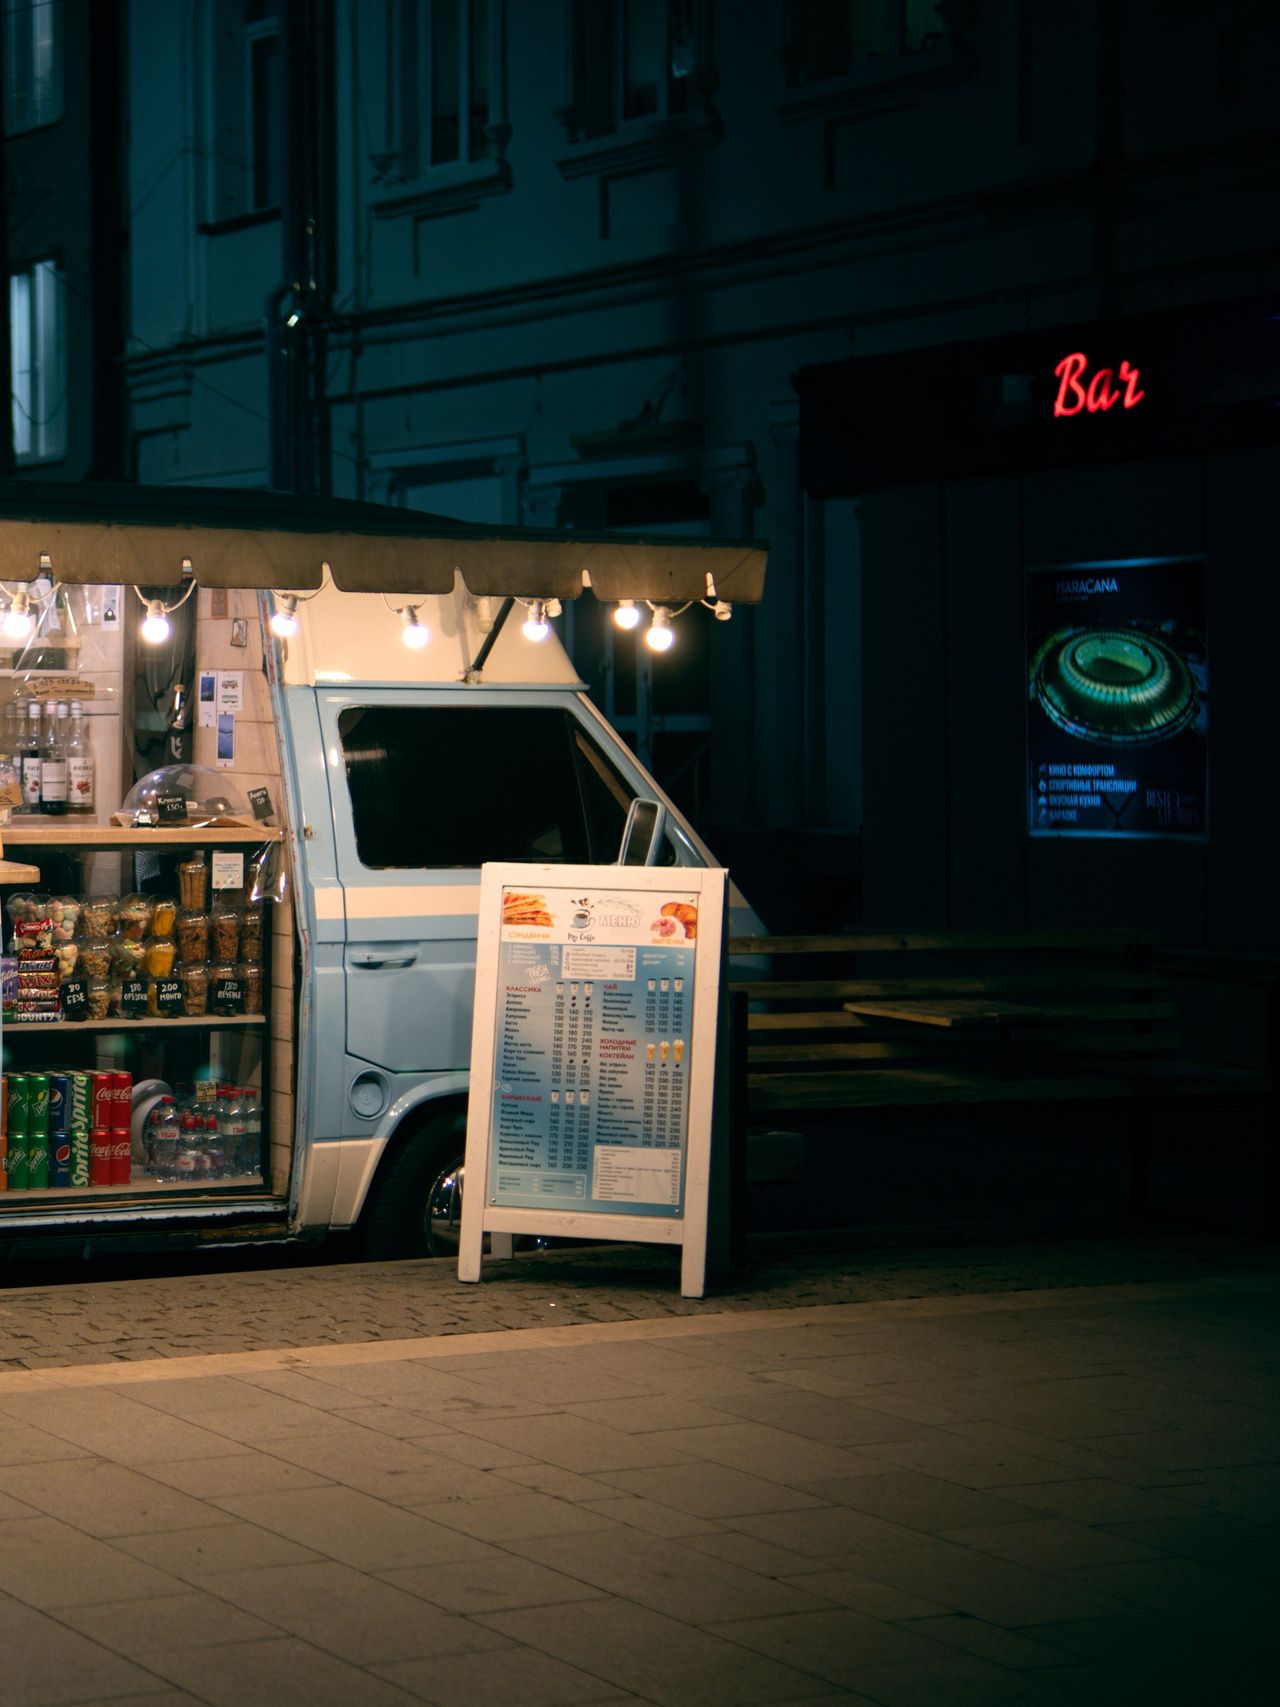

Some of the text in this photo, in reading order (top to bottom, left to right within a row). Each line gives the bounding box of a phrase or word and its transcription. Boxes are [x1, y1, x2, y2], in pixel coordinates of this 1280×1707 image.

[1054, 352, 1145, 418] Bar
[1056, 576, 1118, 595] MARACANA
[1049, 763, 1114, 777] КИНО С КОМФОРТОМ
[1049, 779, 1137, 793] СПОРТИВНЫЕ ТРАНСЛЯЦИИ
[1049, 794, 1101, 808] ВКУСНАЯ КУХНЯ
[1050, 809, 1077, 822] КАРАОКЕ
[599, 915, 641, 928] МЕНЮ
[509, 931, 550, 940] СЭНДВИЧИ
[567, 932, 579, 942] My
[18, 947, 55, 959] Mars
[20, 961, 52, 970] SNICKERS
[68, 983, 81, 992] 80
[161, 983, 178, 992] 200
[224, 981, 238, 991] 180
[67, 992, 85, 1005] БЕЗЕ
[71, 1075, 87, 1130] Sprite
[501, 1094, 542, 1102] ФИРМЕННЫЕ
[72, 1132, 89, 1186] Sprite
